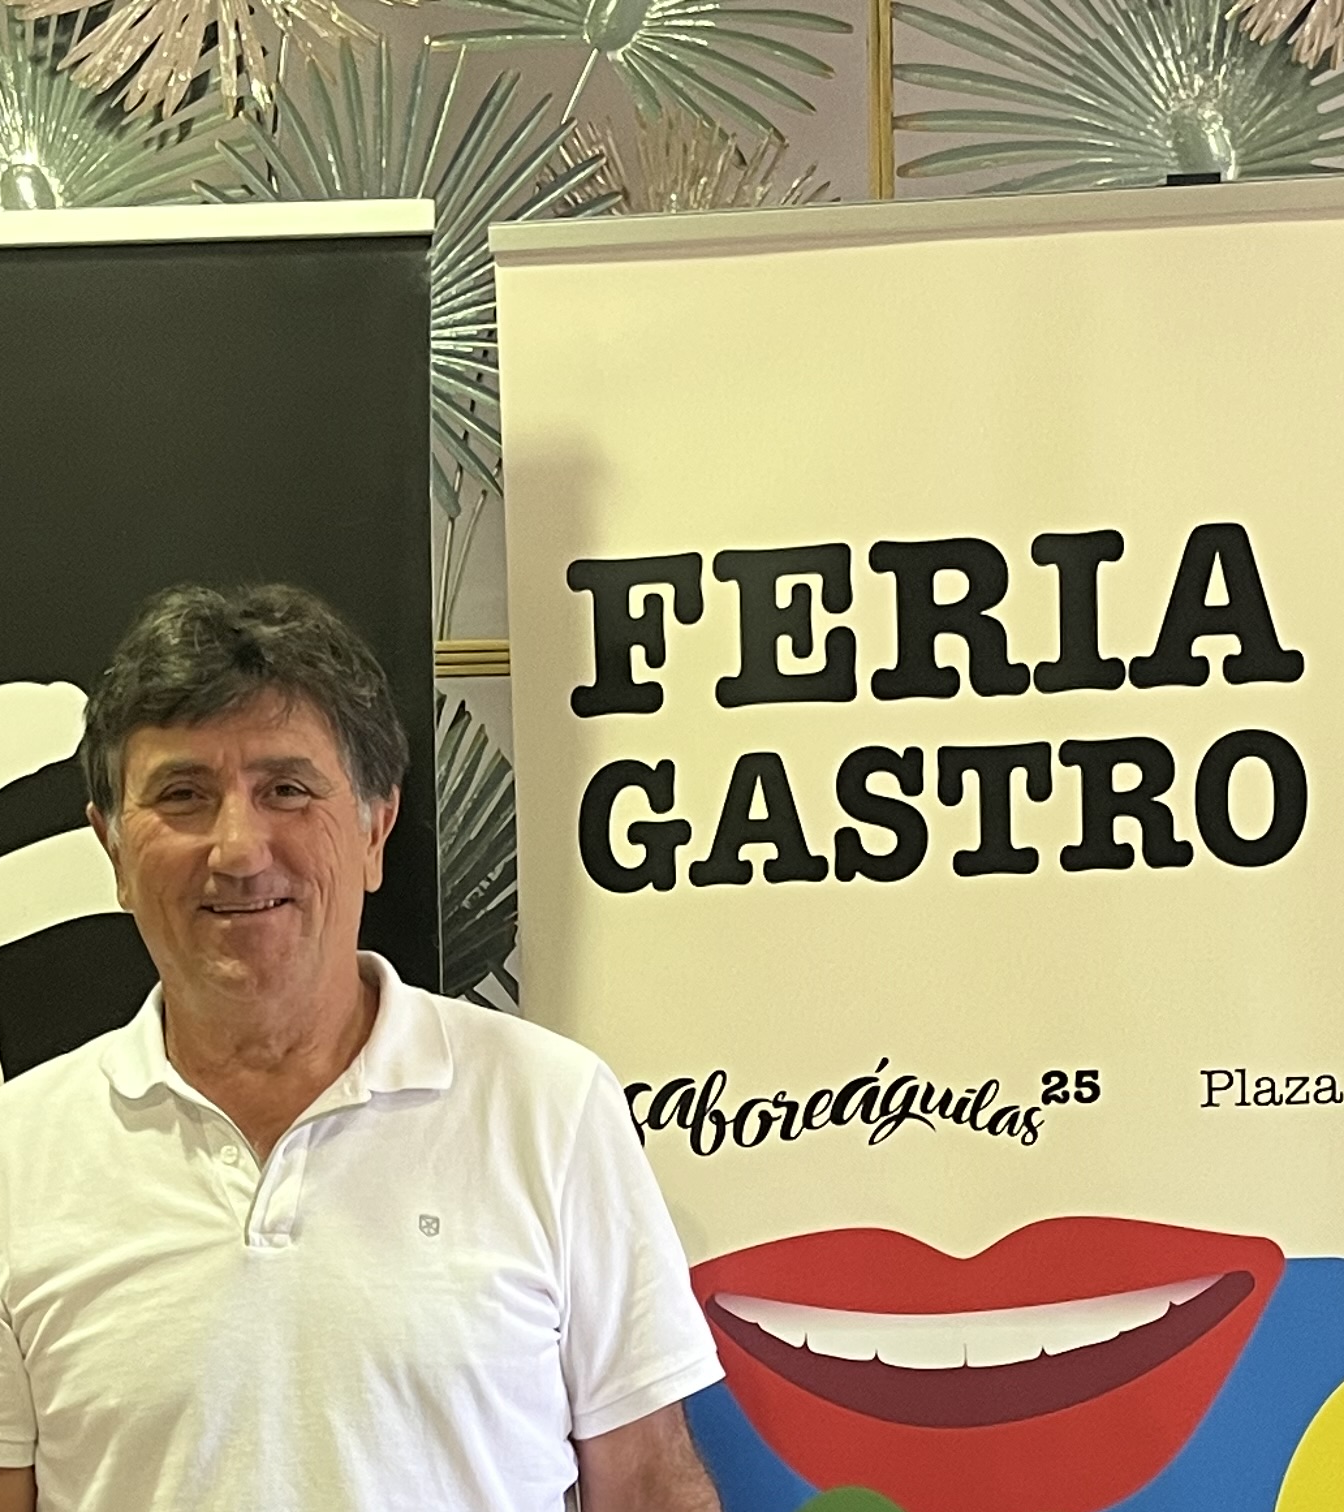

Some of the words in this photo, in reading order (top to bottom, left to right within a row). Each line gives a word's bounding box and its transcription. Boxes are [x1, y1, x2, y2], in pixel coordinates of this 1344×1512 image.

[566, 521, 1305, 720] FERIA
[576, 729, 1310, 893] GASTRO
[1041, 1070, 1102, 1105] 25
[1200, 1068, 1344, 1108] Plaza
